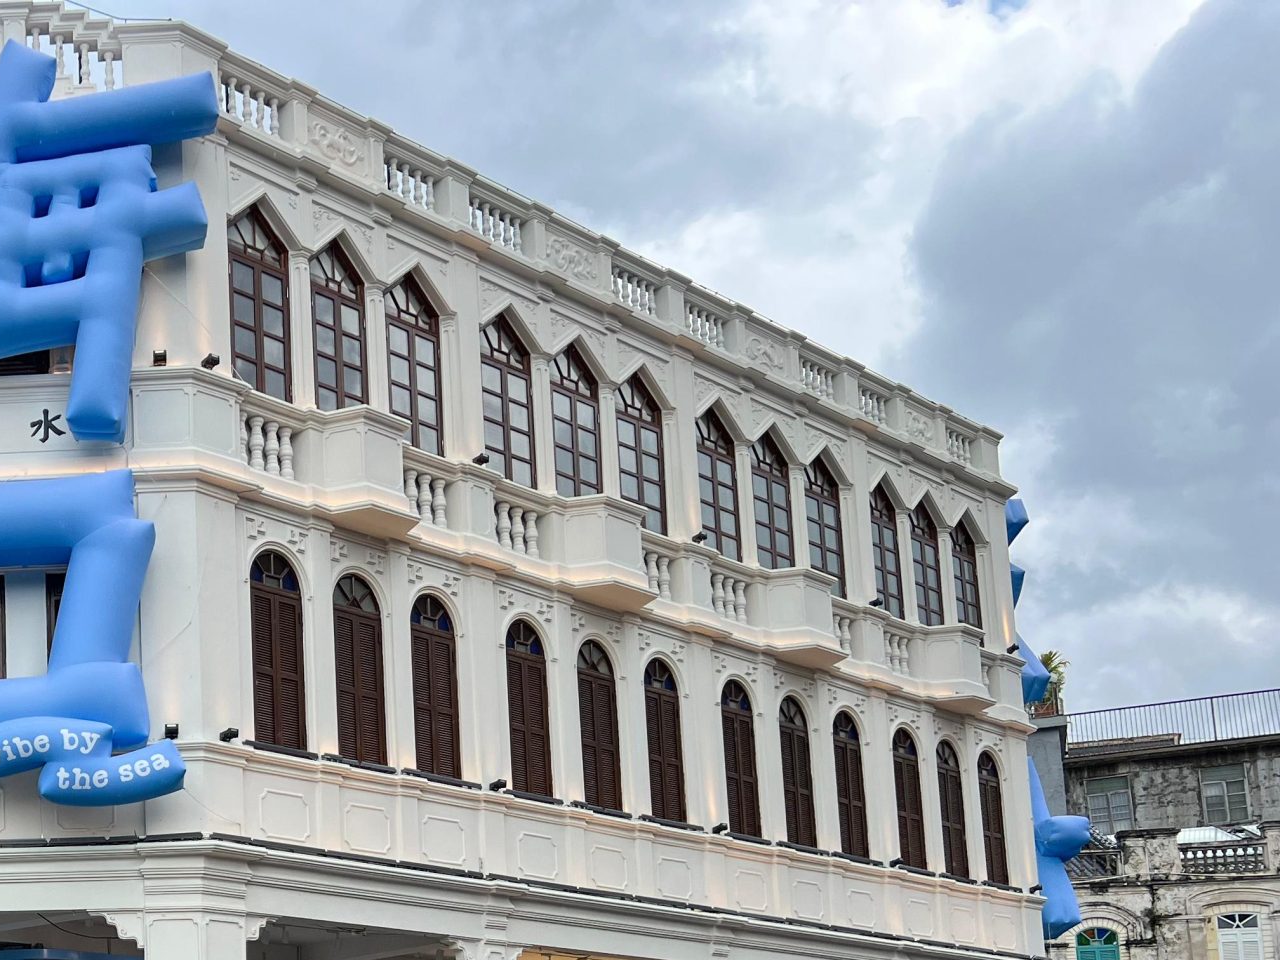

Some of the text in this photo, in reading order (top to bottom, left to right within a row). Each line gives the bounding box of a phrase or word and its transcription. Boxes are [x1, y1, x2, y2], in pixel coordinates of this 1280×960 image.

[60, 728, 101, 755] by
[56, 753, 170, 790] the sea
